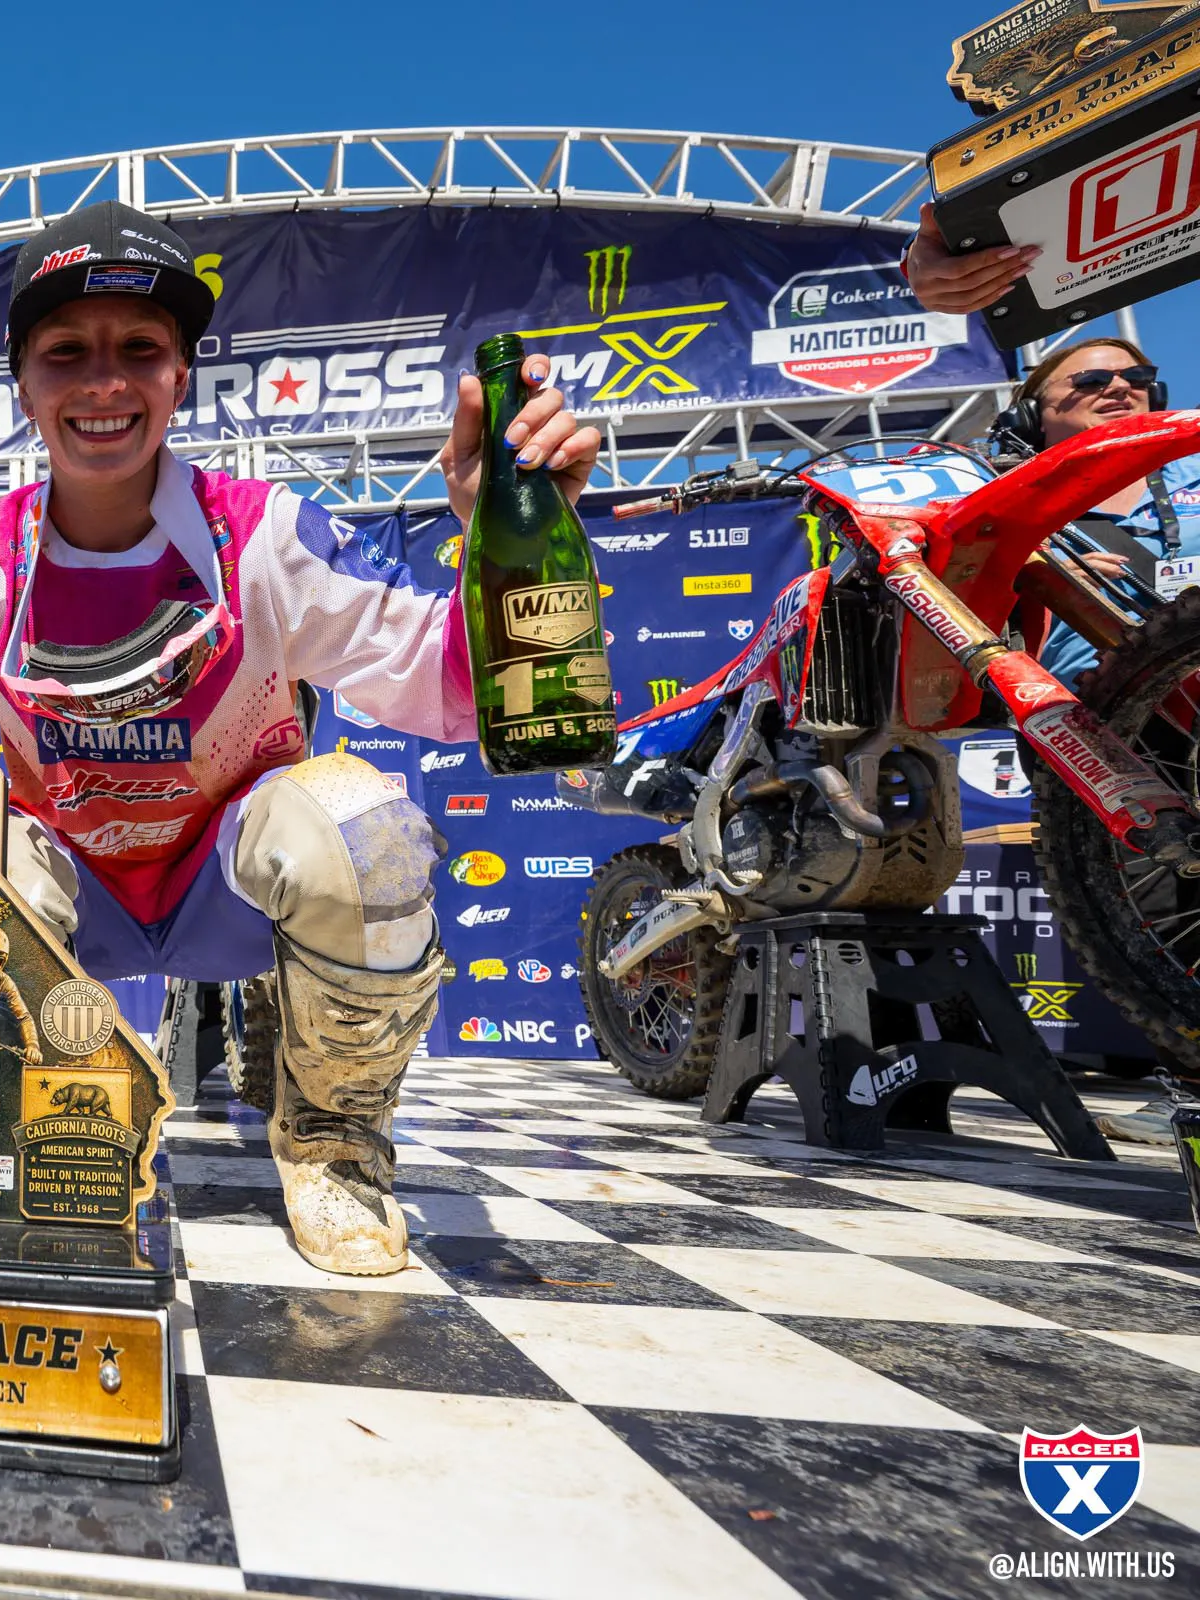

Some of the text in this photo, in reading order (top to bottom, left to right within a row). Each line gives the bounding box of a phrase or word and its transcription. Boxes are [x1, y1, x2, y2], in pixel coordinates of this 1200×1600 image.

[973, 0, 1068, 50] HANGTO
[982, 1, 1071, 53] MOTOCROSS-CLASSIC
[1010, 8, 1068, 45] ANNIVERSARY
[1009, 35, 1031, 48] SINCE
[1028, 61, 1177, 141] PRO WOMEN
[983, 101, 1062, 150] 3RD
[121, 229, 158, 245] BLU
[160, 242, 188, 264] CRU
[1081, 219, 1200, 275] MXTROPHIE
[1108, 244, 1190, 281] MXTROPHIES.COM
[831, 283, 914, 305] Coker Pu
[790, 320, 926, 354] HANGTOWN
[791, 351, 927, 373] MOTOCROSS CLASSIC
[850, 456, 987, 504] 51
[689, 528, 728, 548] 5.11
[606, 546, 654, 554] RACING
[693, 580, 741, 591] Insta360
[513, 591, 589, 620] WMX
[906, 591, 972, 654] SHOWA
[652, 630, 706, 640] MARINES
[58, 722, 185, 750] YAMAHA
[504, 724, 555, 742] JUNE
[562, 722, 581, 738] 6,
[350, 738, 406, 753] synchrony
[1050, 727, 1116, 786] MOTHER
[437, 753, 466, 766] UFO
[472, 853, 492, 863] Bass
[473, 859, 592, 876] Pro WPS
[474, 871, 500, 882] Shops
[476, 908, 511, 922] UFO
[520, 960, 540, 981] VP
[48, 982, 107, 1006] DIRT DIGGERS
[63, 993, 92, 1006] NORTH
[43, 1014, 112, 1053] MOTORCYCLE CLUB
[503, 1020, 557, 1043] NBC
[872, 1054, 918, 1092] UFO
[26, 1121, 126, 1143] CALIFORNIA ROOTS
[41, 1145, 114, 1158] AMERICAN SPIRIT
[27, 1168, 124, 1184] "BUILT ON TRADITION.
[29, 1182, 124, 1197] DRIVEN BY PASSION."
[53, 1202, 99, 1214] EST. 1968
